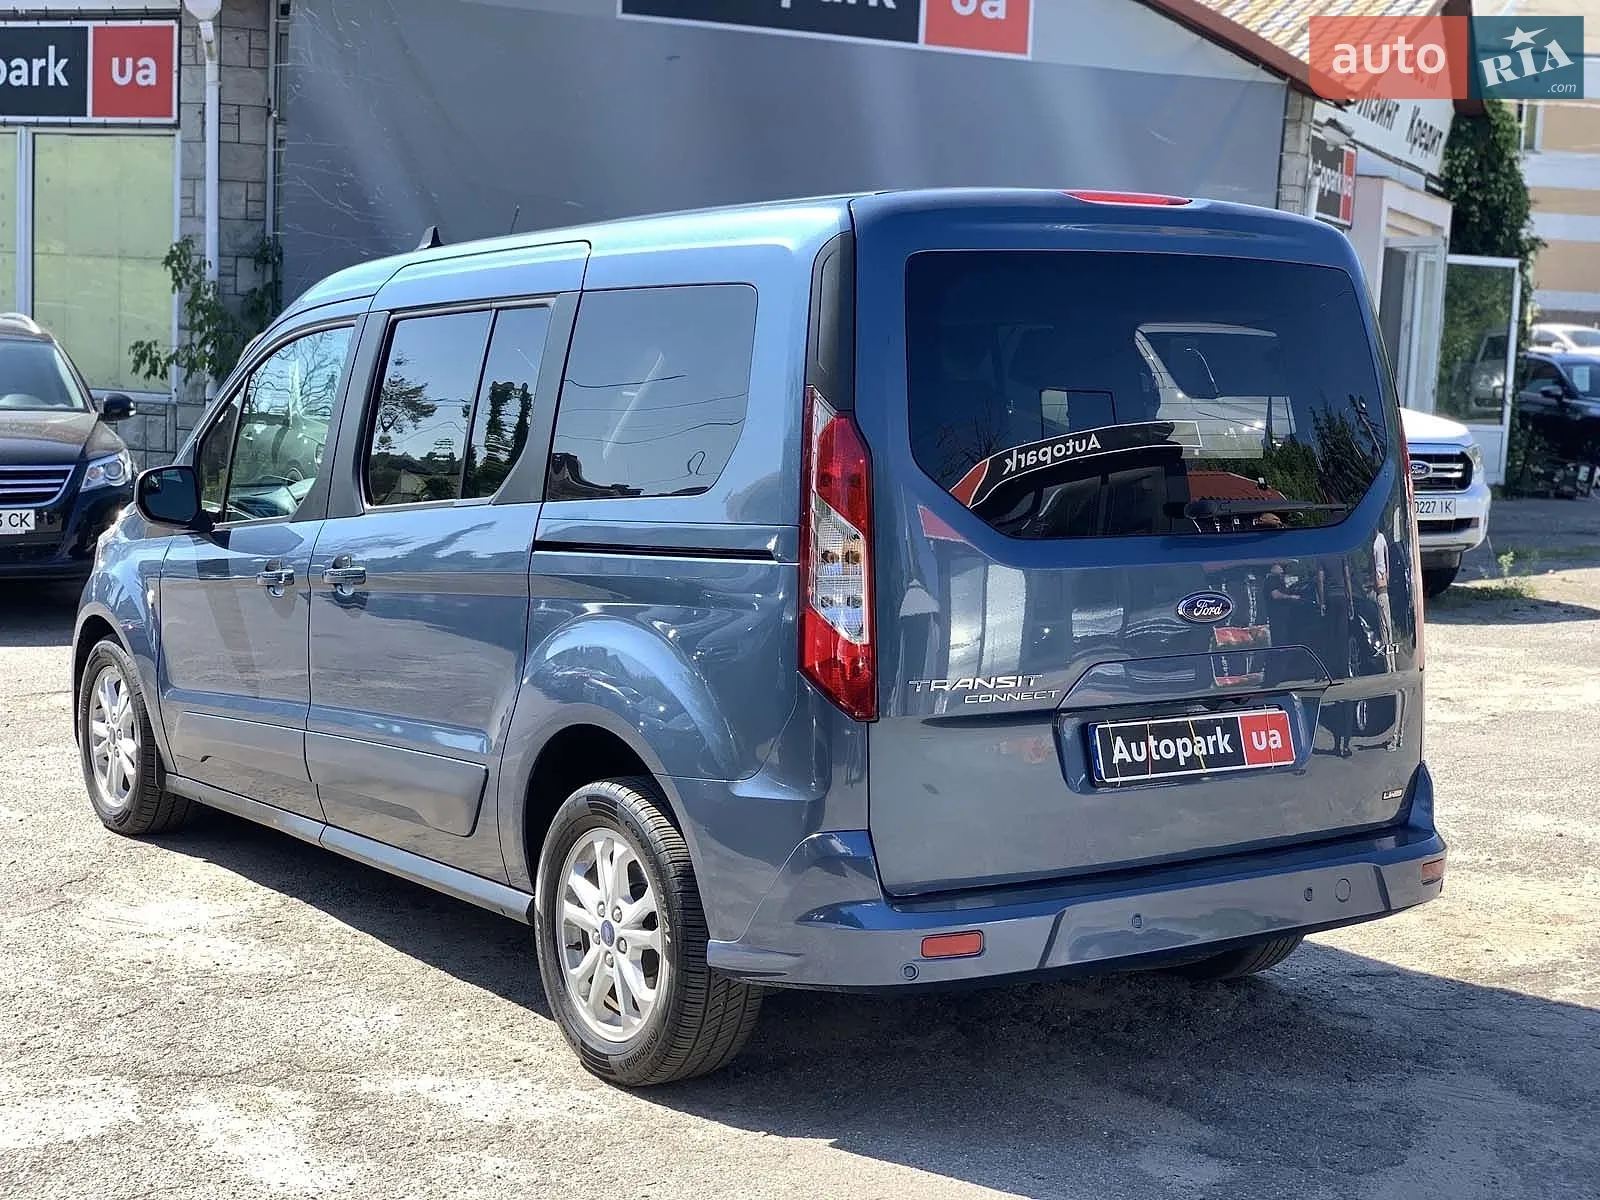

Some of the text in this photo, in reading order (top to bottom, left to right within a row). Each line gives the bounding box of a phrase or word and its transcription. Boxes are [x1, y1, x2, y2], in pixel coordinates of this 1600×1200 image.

[0, 45, 157, 87] ark ua
[8, 512, 32, 528] CK
[1193, 598, 1223, 616] Ford
[908, 674, 1044, 693] TRANSIT
[963, 689, 1061, 704] CONNECT
[1112, 726, 1283, 766] Autopark ua
